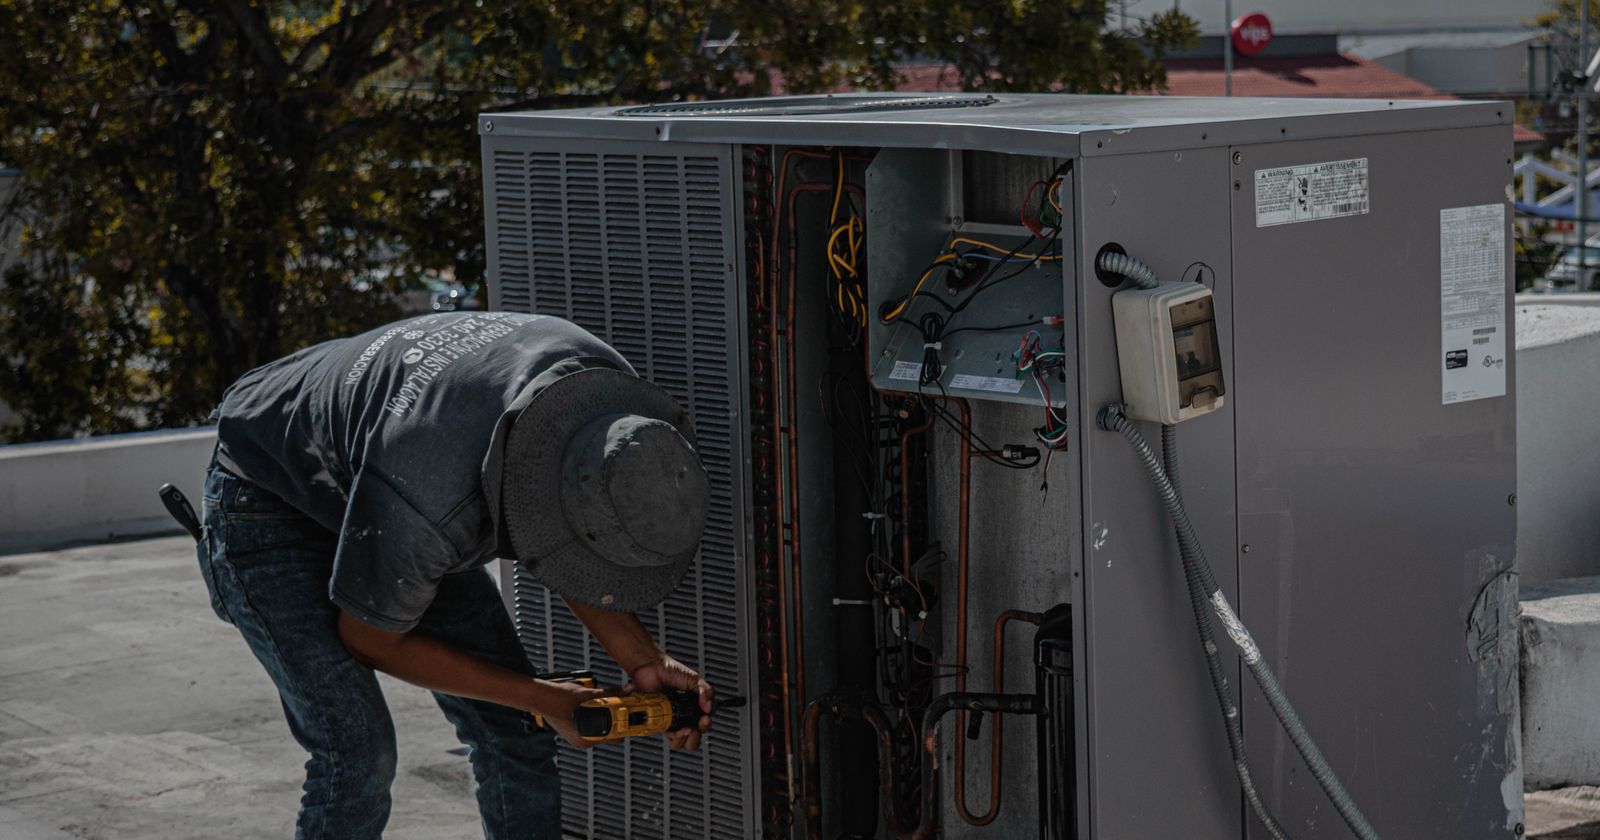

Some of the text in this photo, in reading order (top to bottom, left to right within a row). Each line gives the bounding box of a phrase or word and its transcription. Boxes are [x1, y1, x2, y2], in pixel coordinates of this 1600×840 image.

[1239, 22, 1270, 46] vips
[1267, 169, 1294, 177] WARNING
[1319, 161, 1362, 172] AVERTISSEMENT
[452, 318, 484, 334] 240
[417, 329, 459, 351] 3230
[384, 351, 453, 417] INSTALACIÓN
